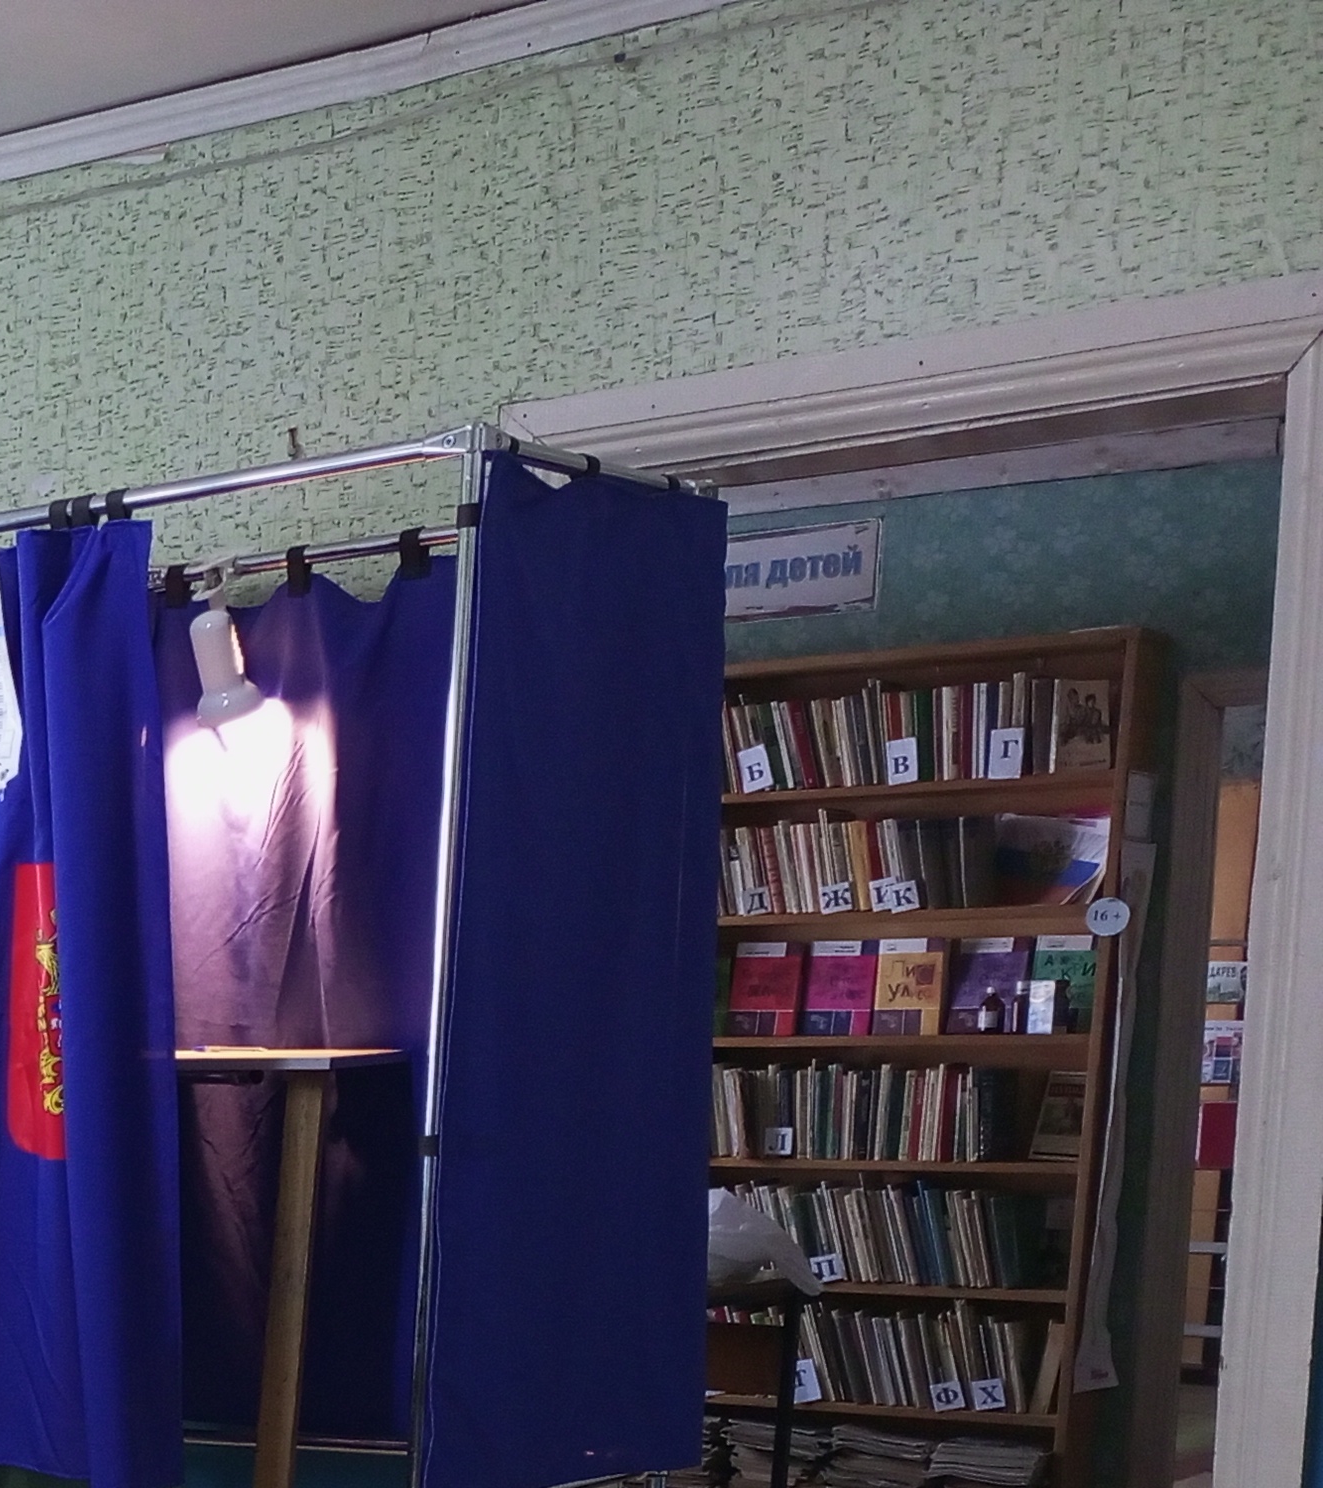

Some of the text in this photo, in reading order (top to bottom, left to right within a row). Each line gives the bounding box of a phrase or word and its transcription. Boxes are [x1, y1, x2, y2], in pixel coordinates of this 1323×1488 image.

[726, 544, 862, 589] ля детей
[1001, 739, 1019, 759] Г
[747, 762, 764, 783] Б
[748, 892, 768, 913] Д
[822, 887, 851, 909] Ж
[1093, 910, 1108, 922] 16
[769, 1134, 787, 1152] Л
[936, 1387, 959, 1405] Ф
[979, 1385, 1002, 1405] Х
